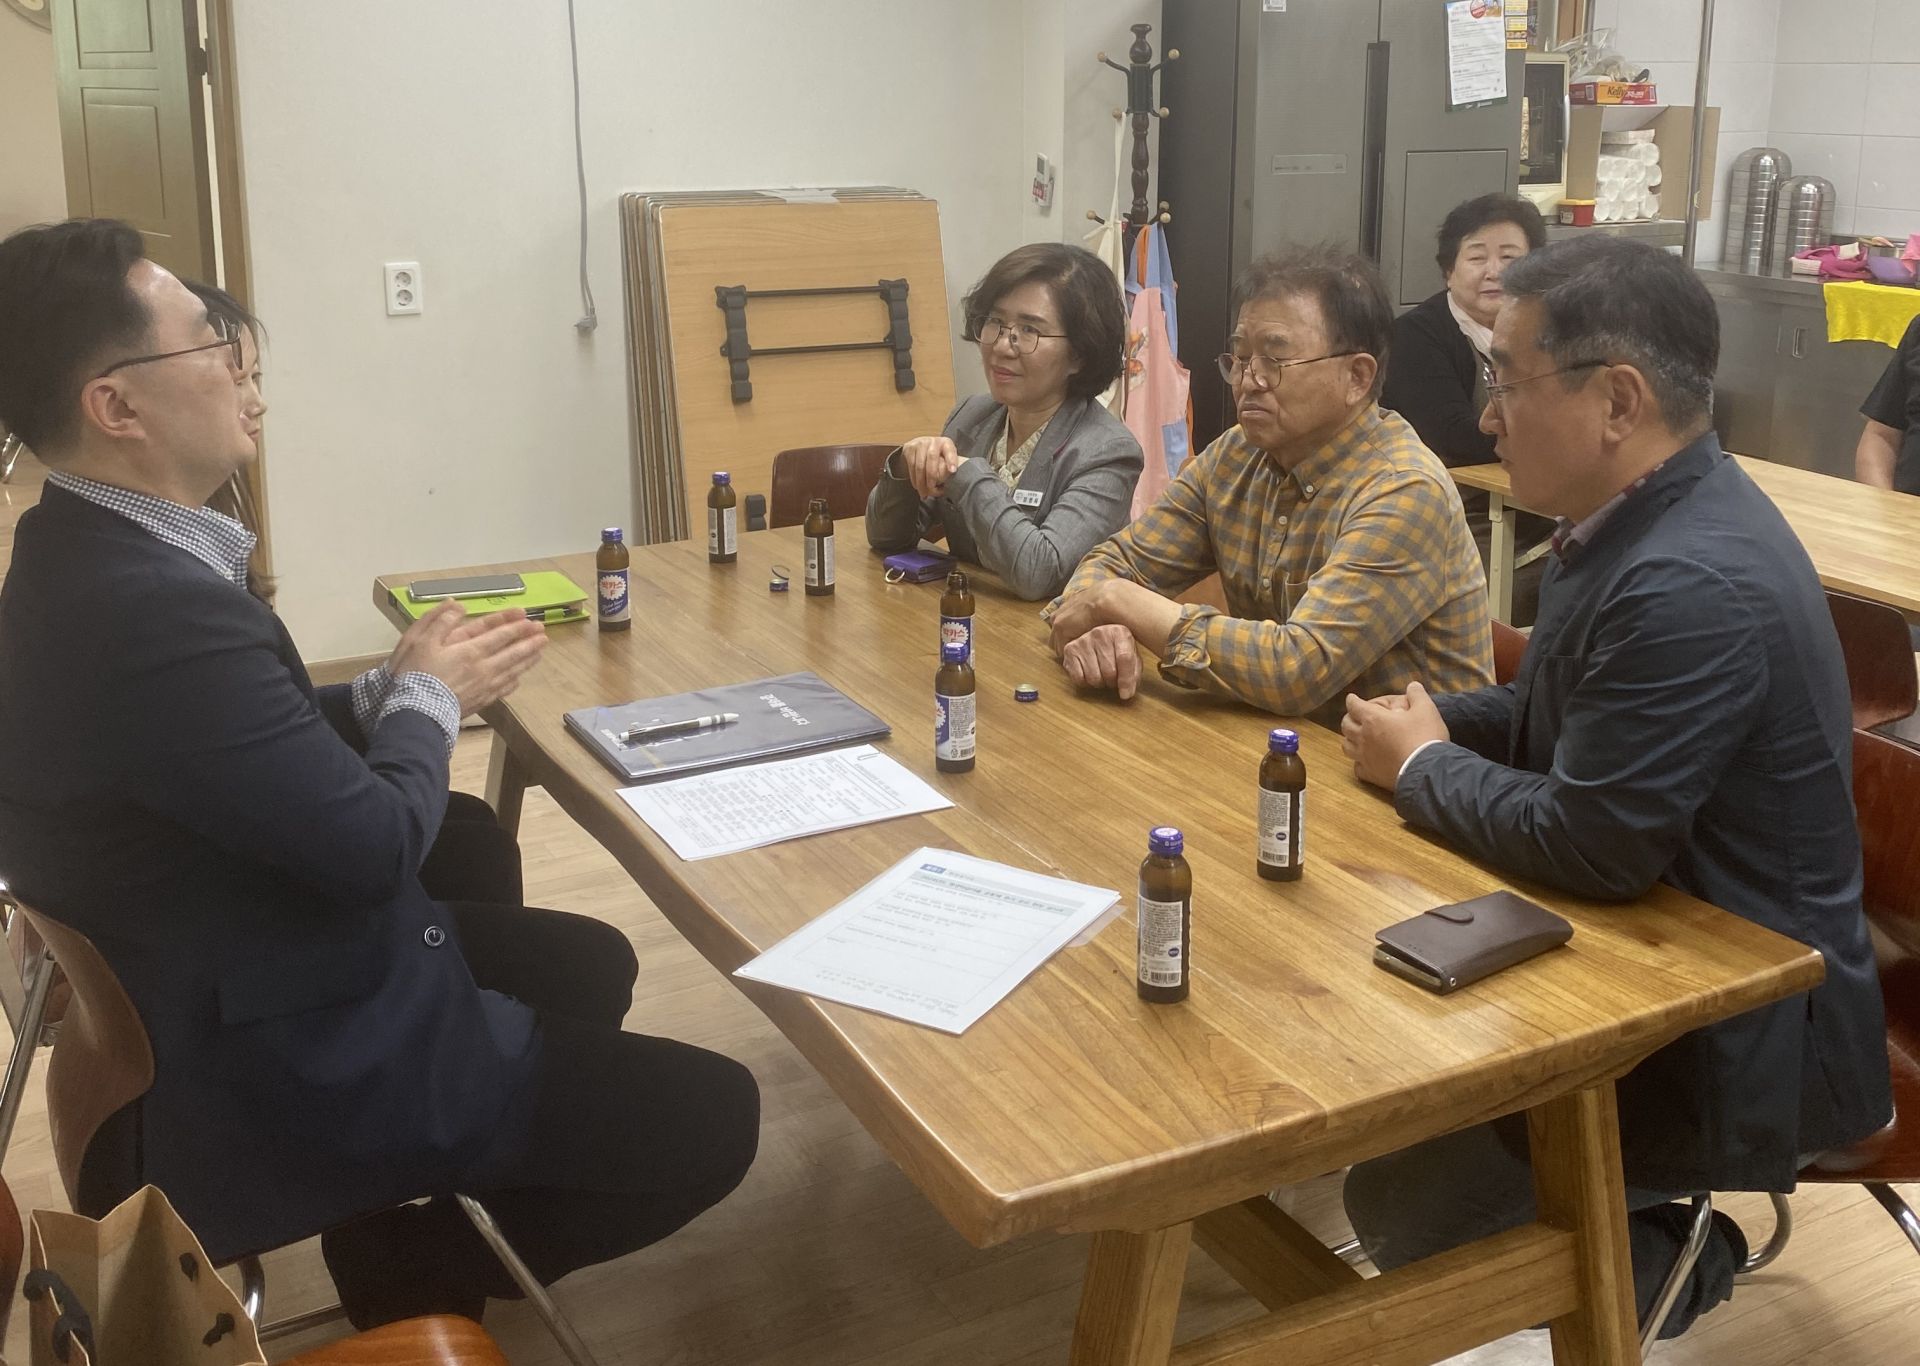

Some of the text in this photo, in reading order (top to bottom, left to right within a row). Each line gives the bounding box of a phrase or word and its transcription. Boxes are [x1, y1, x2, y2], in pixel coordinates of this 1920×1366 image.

[1607, 86, 1626, 98] Kelly
[602, 581, 623, 590] 박카스
[943, 628, 965, 638] 박카스
